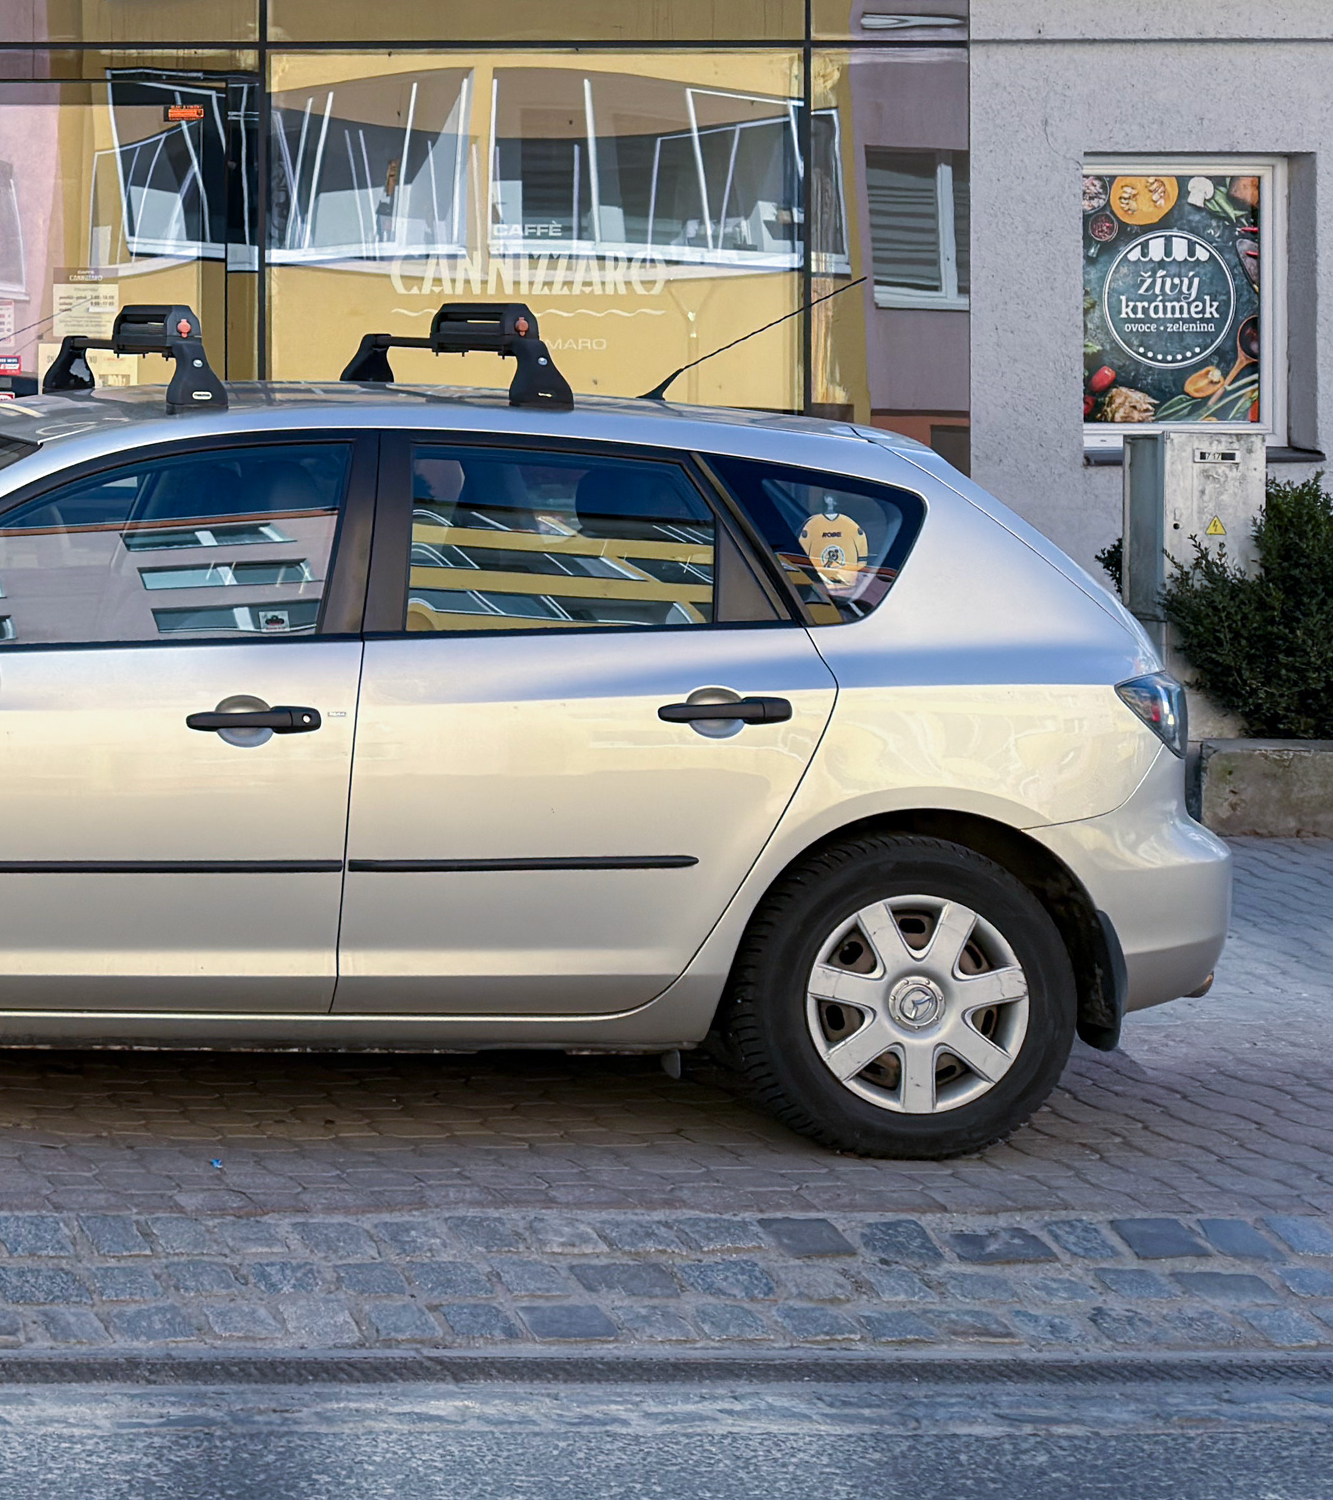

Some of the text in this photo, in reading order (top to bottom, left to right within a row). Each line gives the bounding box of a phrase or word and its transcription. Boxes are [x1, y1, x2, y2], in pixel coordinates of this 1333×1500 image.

[492, 220, 563, 236] CAFFÈ
[389, 249, 668, 296] CANNIZZARO
[1137, 269, 1200, 302] živý
[1119, 295, 1220, 318] krámek
[1124, 321, 1215, 332] ovoce zelenina
[544, 338, 608, 350] MARO
